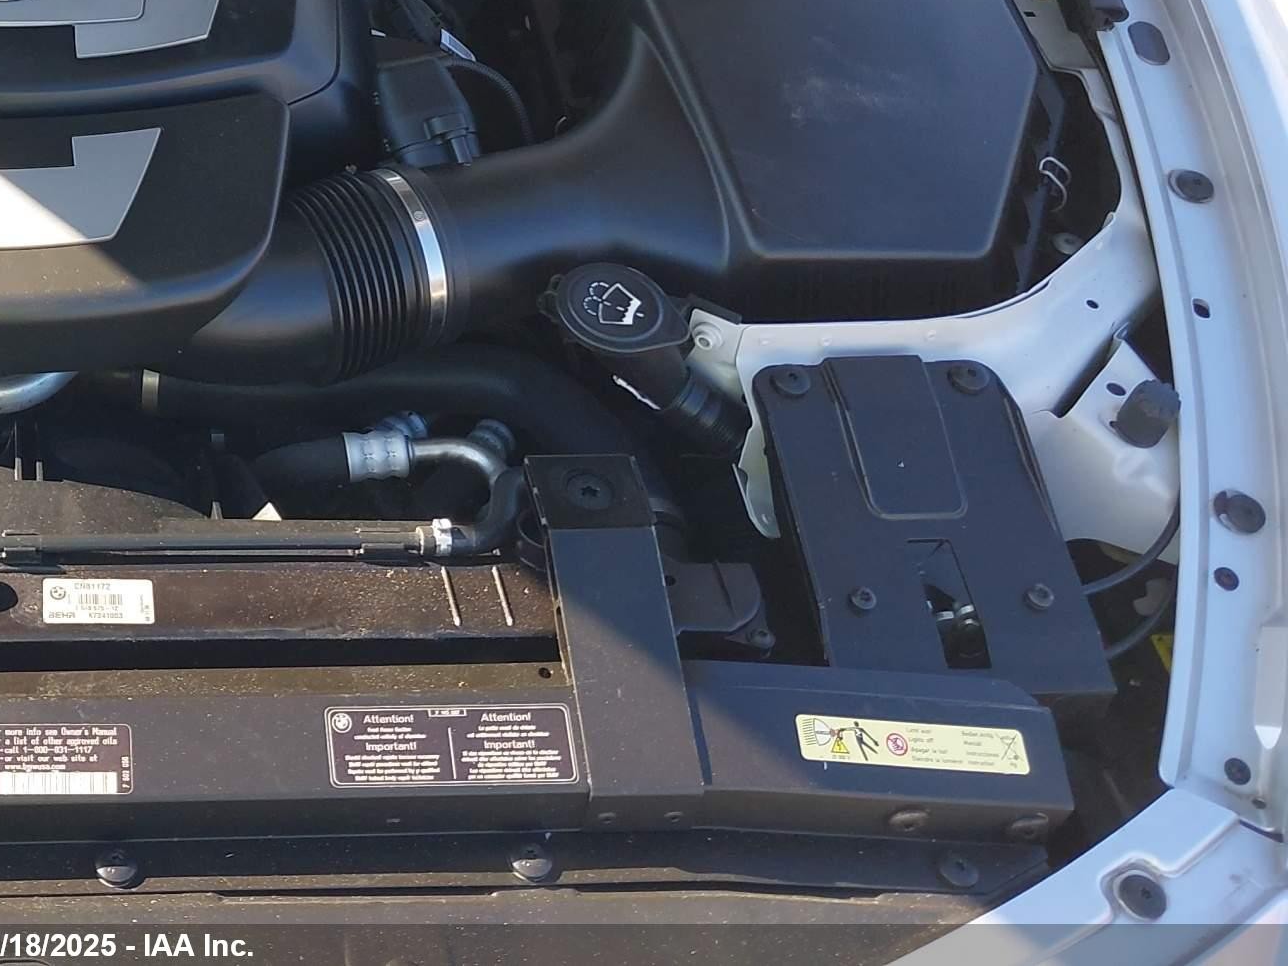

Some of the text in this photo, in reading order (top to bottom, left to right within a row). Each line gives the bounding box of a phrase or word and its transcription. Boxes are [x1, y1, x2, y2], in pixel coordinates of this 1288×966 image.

[363, 714, 414, 724] Attention!
[480, 712, 531, 722] Attention!
[26, 727, 42, 736] info
[13, 736, 27, 745] list
[30, 736, 40, 745] of
[42, 736, 63, 745] other
[483, 739, 535, 750] Important!
[365, 741, 416, 752] Important!
[16, 754, 34, 762] visit
